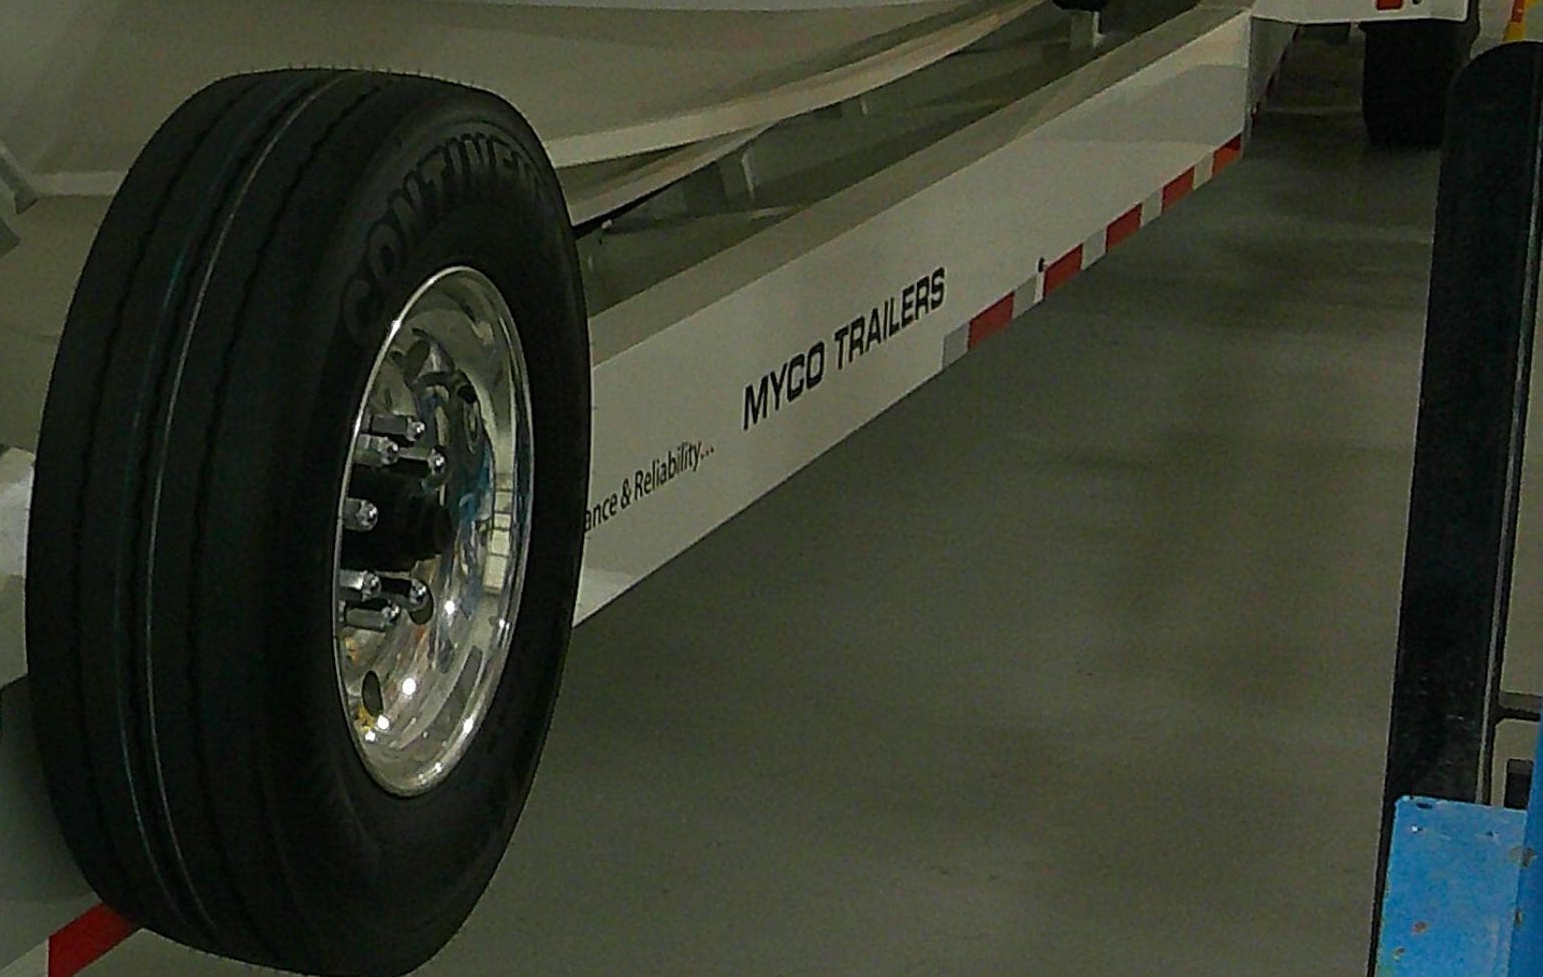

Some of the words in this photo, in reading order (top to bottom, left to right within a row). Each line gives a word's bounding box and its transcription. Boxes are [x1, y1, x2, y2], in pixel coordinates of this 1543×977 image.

[742, 340, 826, 431] MYCO
[833, 266, 946, 370] TRAILERS
[620, 478, 633, 510] &
